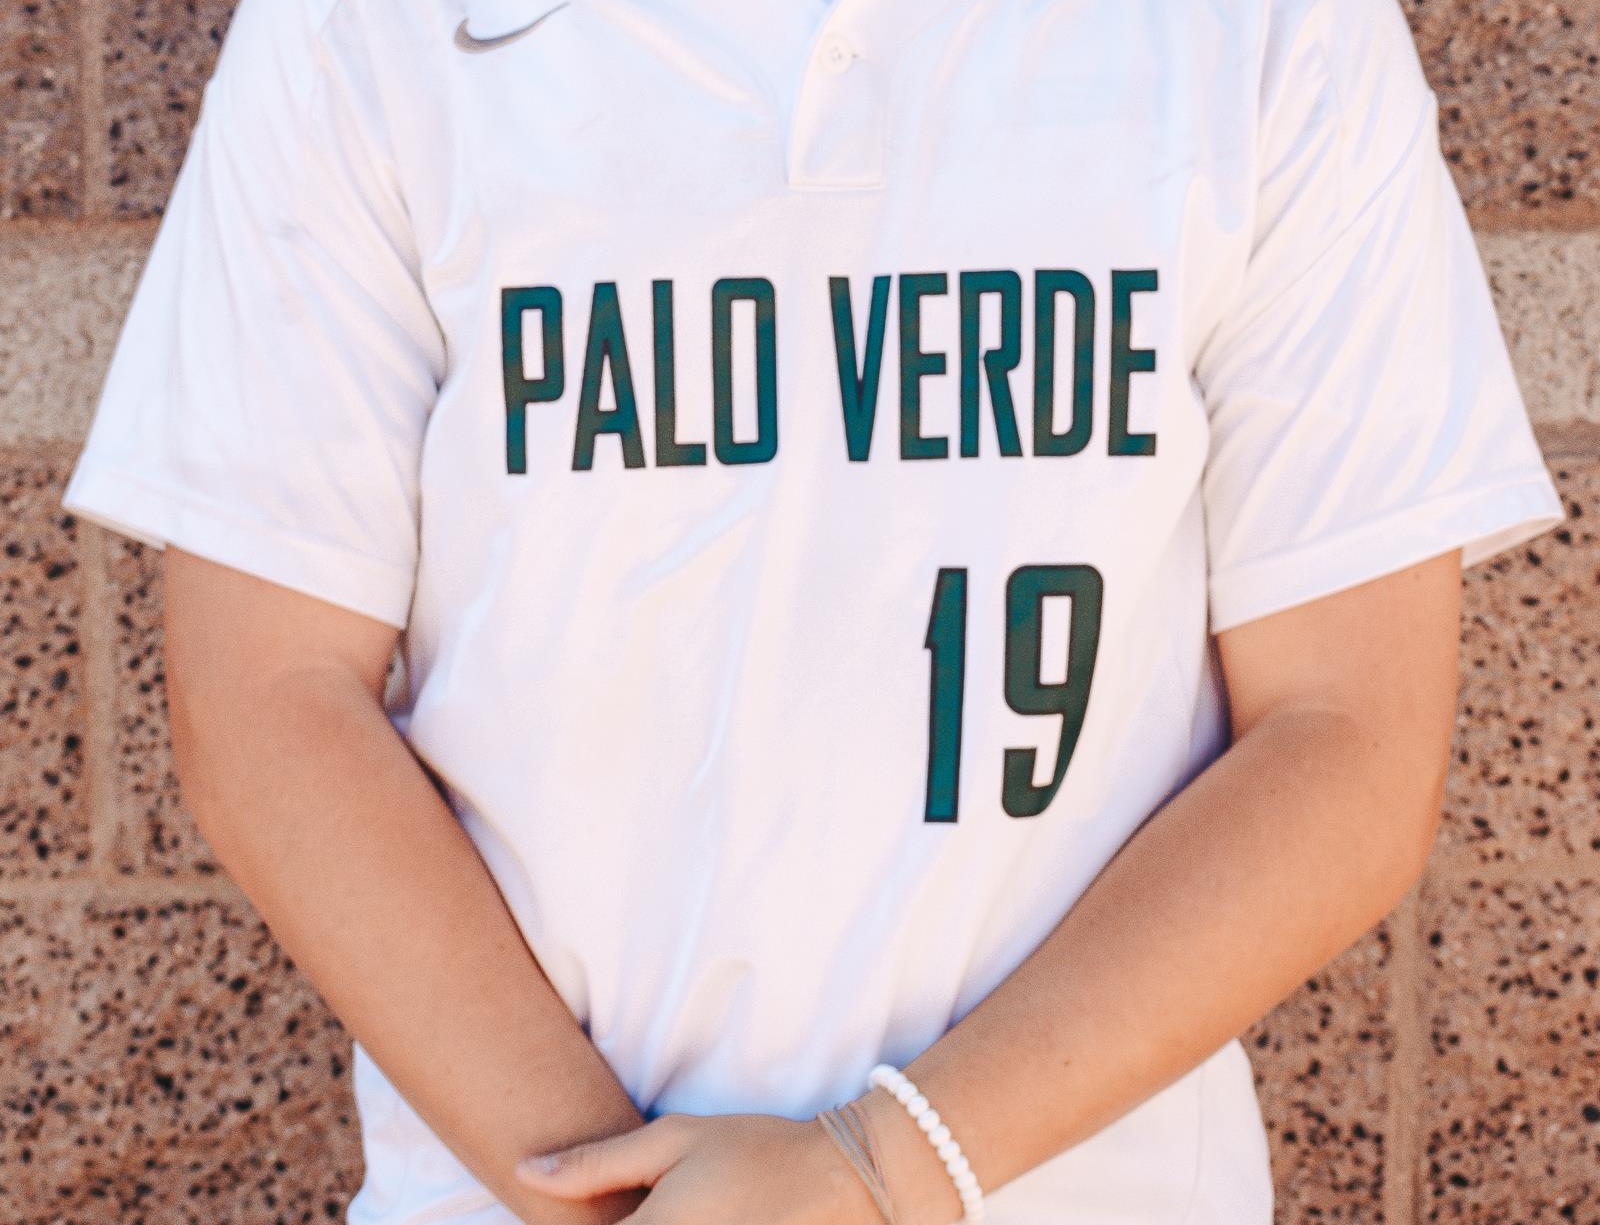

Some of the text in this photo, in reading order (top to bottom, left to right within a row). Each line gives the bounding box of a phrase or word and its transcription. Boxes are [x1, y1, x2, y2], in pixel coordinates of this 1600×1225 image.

[500, 269, 1159, 475] PALO VERDE
[923, 564, 1104, 824] 19
